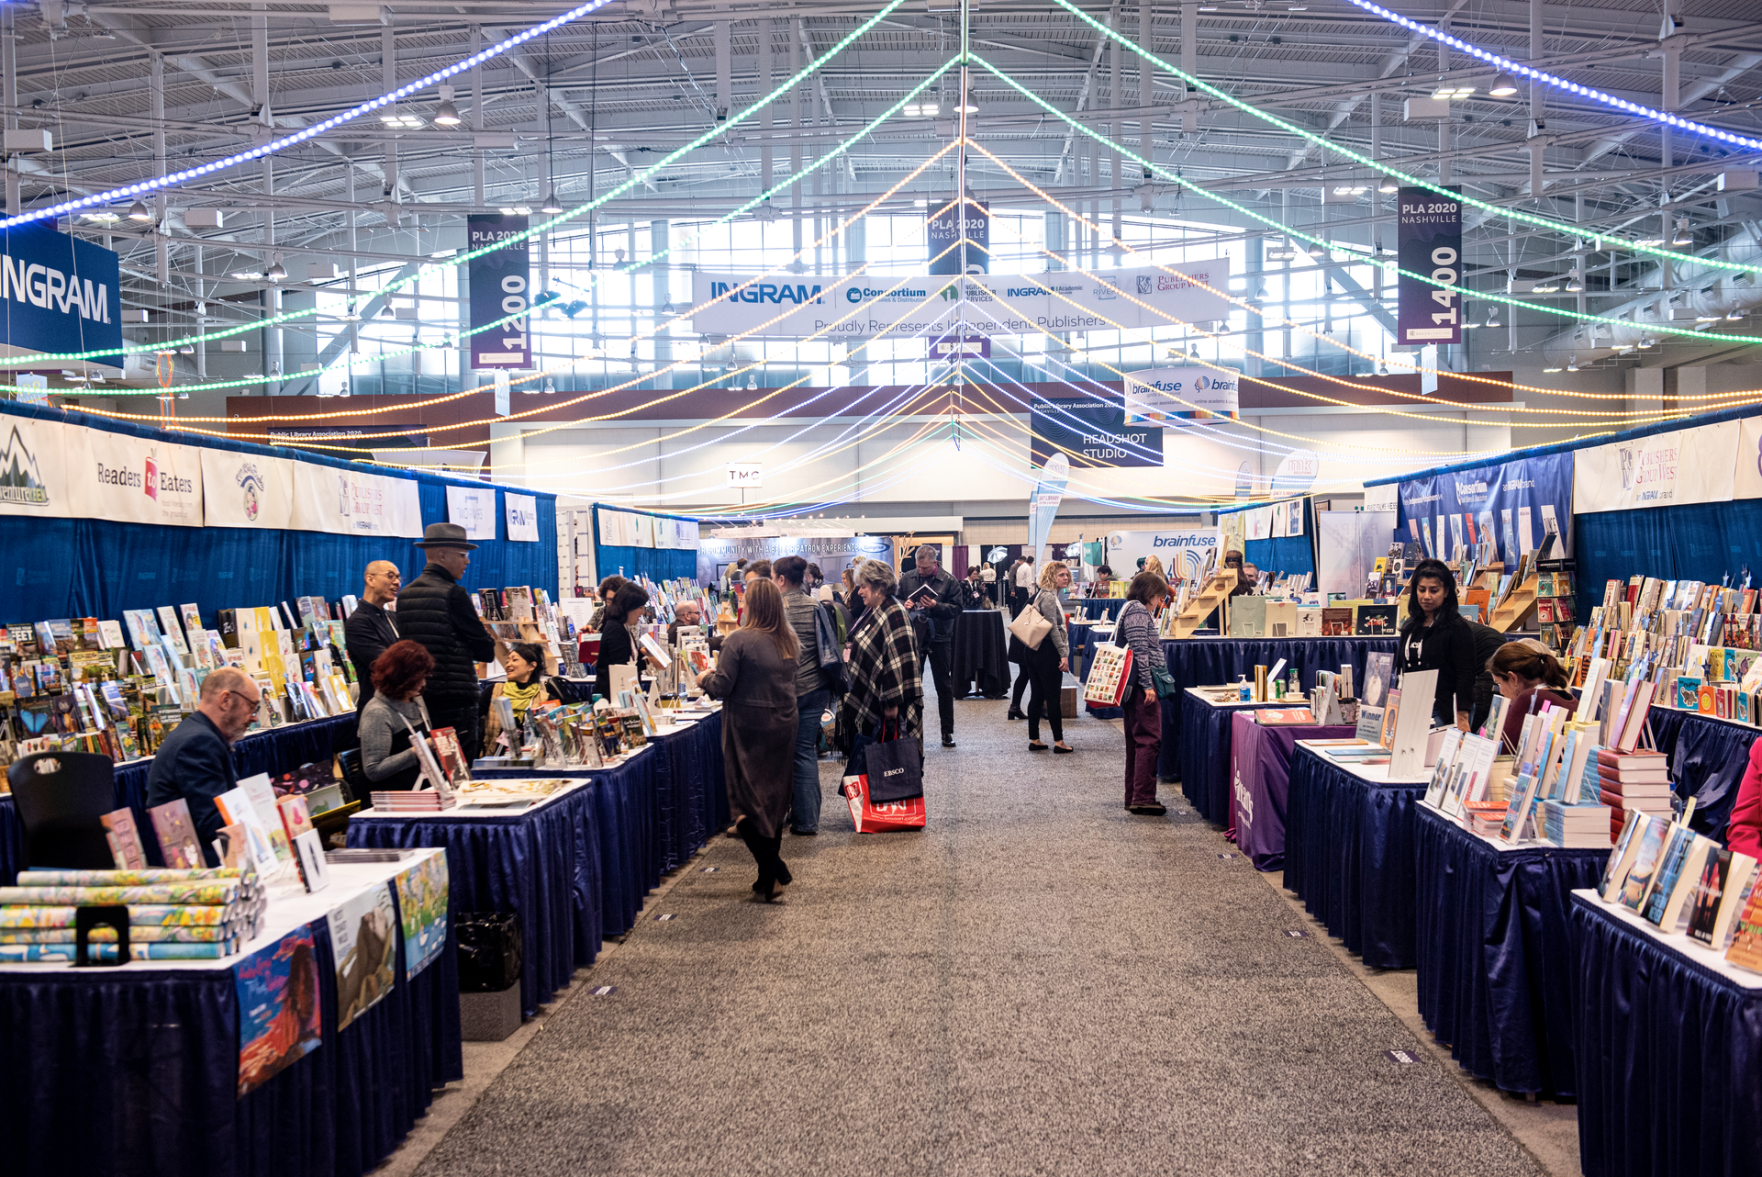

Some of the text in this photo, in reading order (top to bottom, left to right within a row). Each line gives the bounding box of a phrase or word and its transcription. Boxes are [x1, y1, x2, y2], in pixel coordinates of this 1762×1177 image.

[1402, 202, 1457, 214] PLA 2020
[931, 219, 953, 230] PLA
[1401, 215, 1457, 224] NASHVILLE
[472, 231, 495, 242] PLA
[472, 242, 525, 250] NASVILLE
[0, 253, 108, 324] NGRAM
[1157, 281, 1186, 291] GROUP
[1431, 246, 1457, 325] 1400
[711, 281, 822, 304] INGRAM
[863, 288, 926, 298] Consortium
[1007, 286, 1054, 298] INGRAM
[1093, 288, 1119, 296] RIVER
[501, 275, 527, 350] 1200
[814, 319, 865, 334] Proudly
[869, 318, 945, 335] Represents
[1037, 315, 1106, 328] Publishers
[1132, 381, 1182, 394] brainfuse
[1052, 403, 1072, 411] ibrary
[290, 431, 311, 439] Library
[1083, 433, 1148, 445] HEADSHOT
[1083, 449, 1128, 459] STUDIO
[98, 462, 141, 488] Readers
[147, 470, 157, 488] to
[729, 470, 760, 480] TMC
[160, 471, 192, 493] Eaters
[1153, 534, 1217, 548] brainfuse
[796, 544, 820, 553] PATRON
[821, 543, 861, 553] EXPERIENCE
[12, 630, 33, 641] FEET
[1361, 709, 1382, 721] Winner
[883, 767, 904, 778] EBSCO
